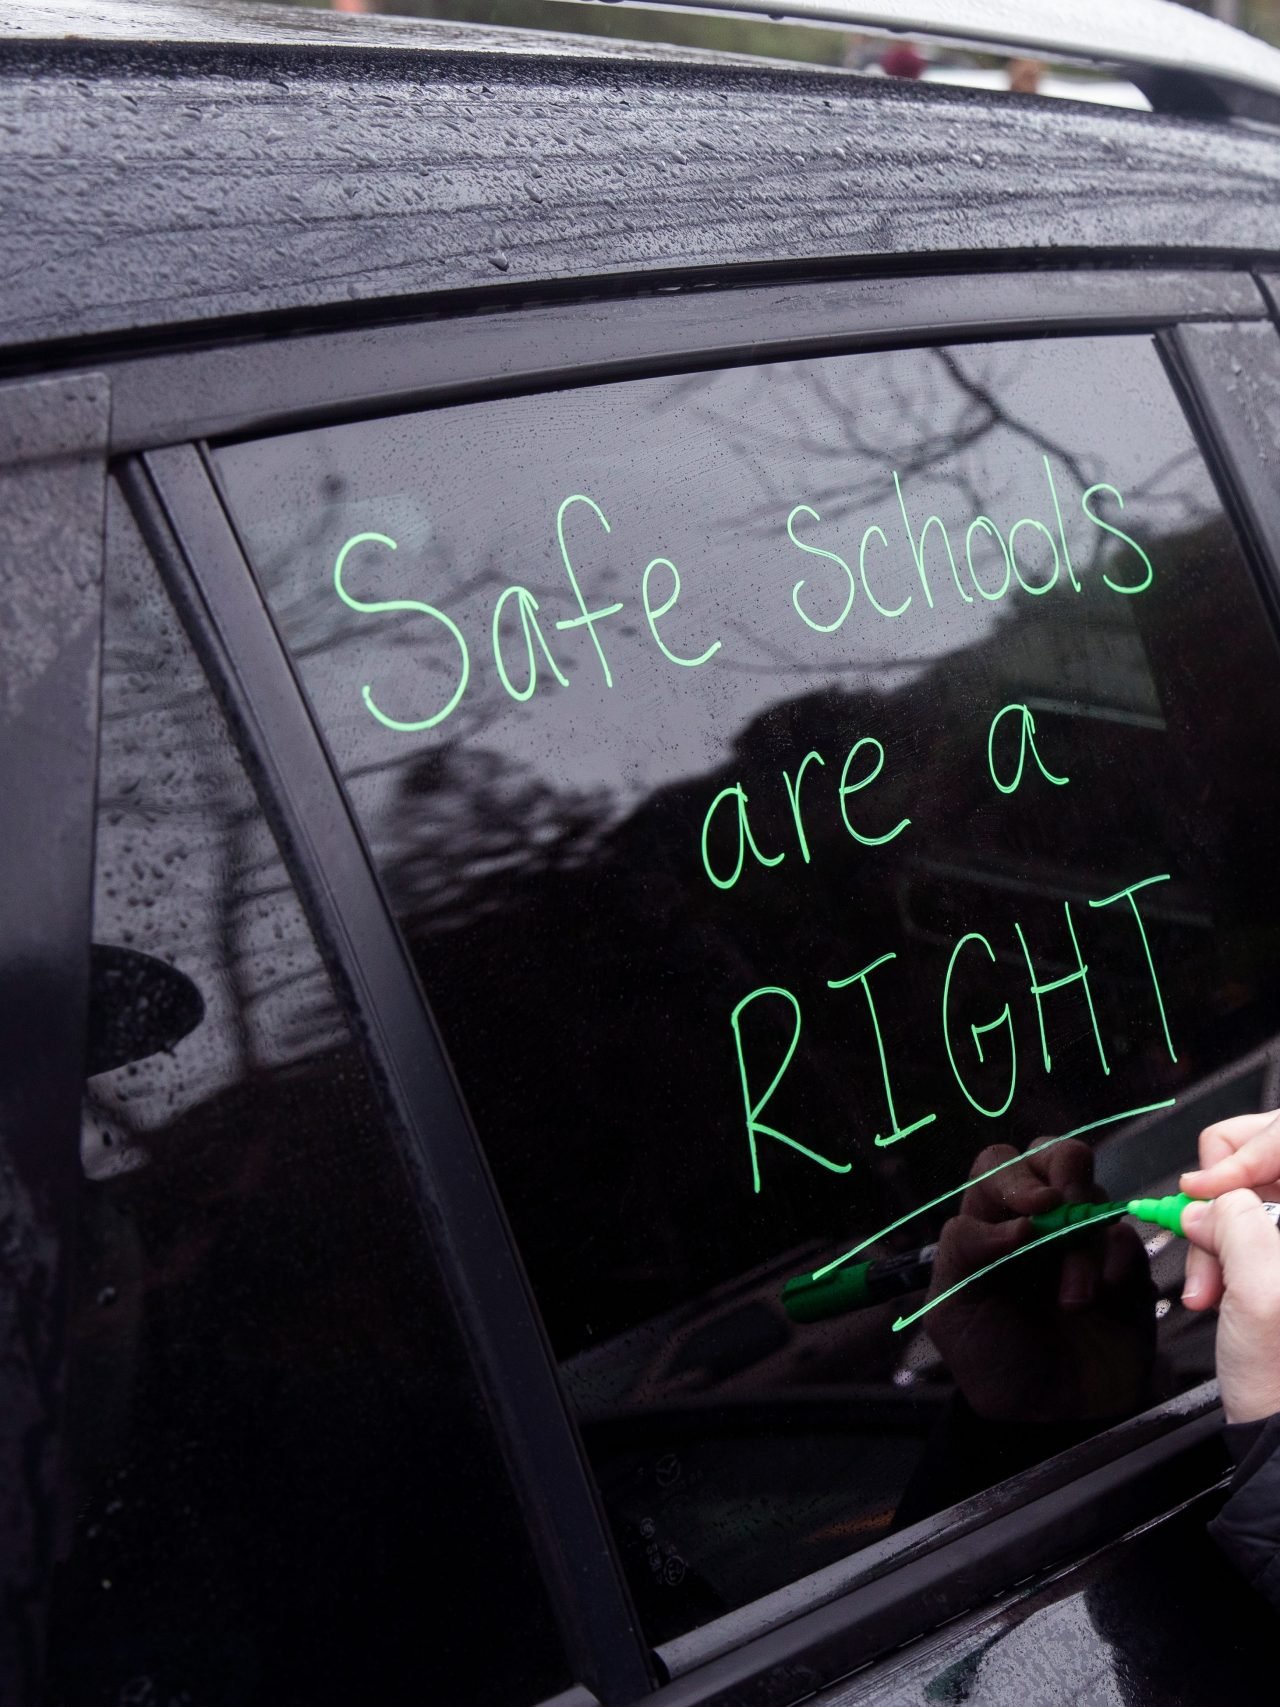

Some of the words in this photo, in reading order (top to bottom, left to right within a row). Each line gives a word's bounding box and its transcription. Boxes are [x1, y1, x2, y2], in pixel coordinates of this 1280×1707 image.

[333, 494, 722, 731] Safe
[700, 736, 911, 890] are
[987, 703, 1071, 795] a
[731, 874, 1177, 1194] RIGHT
